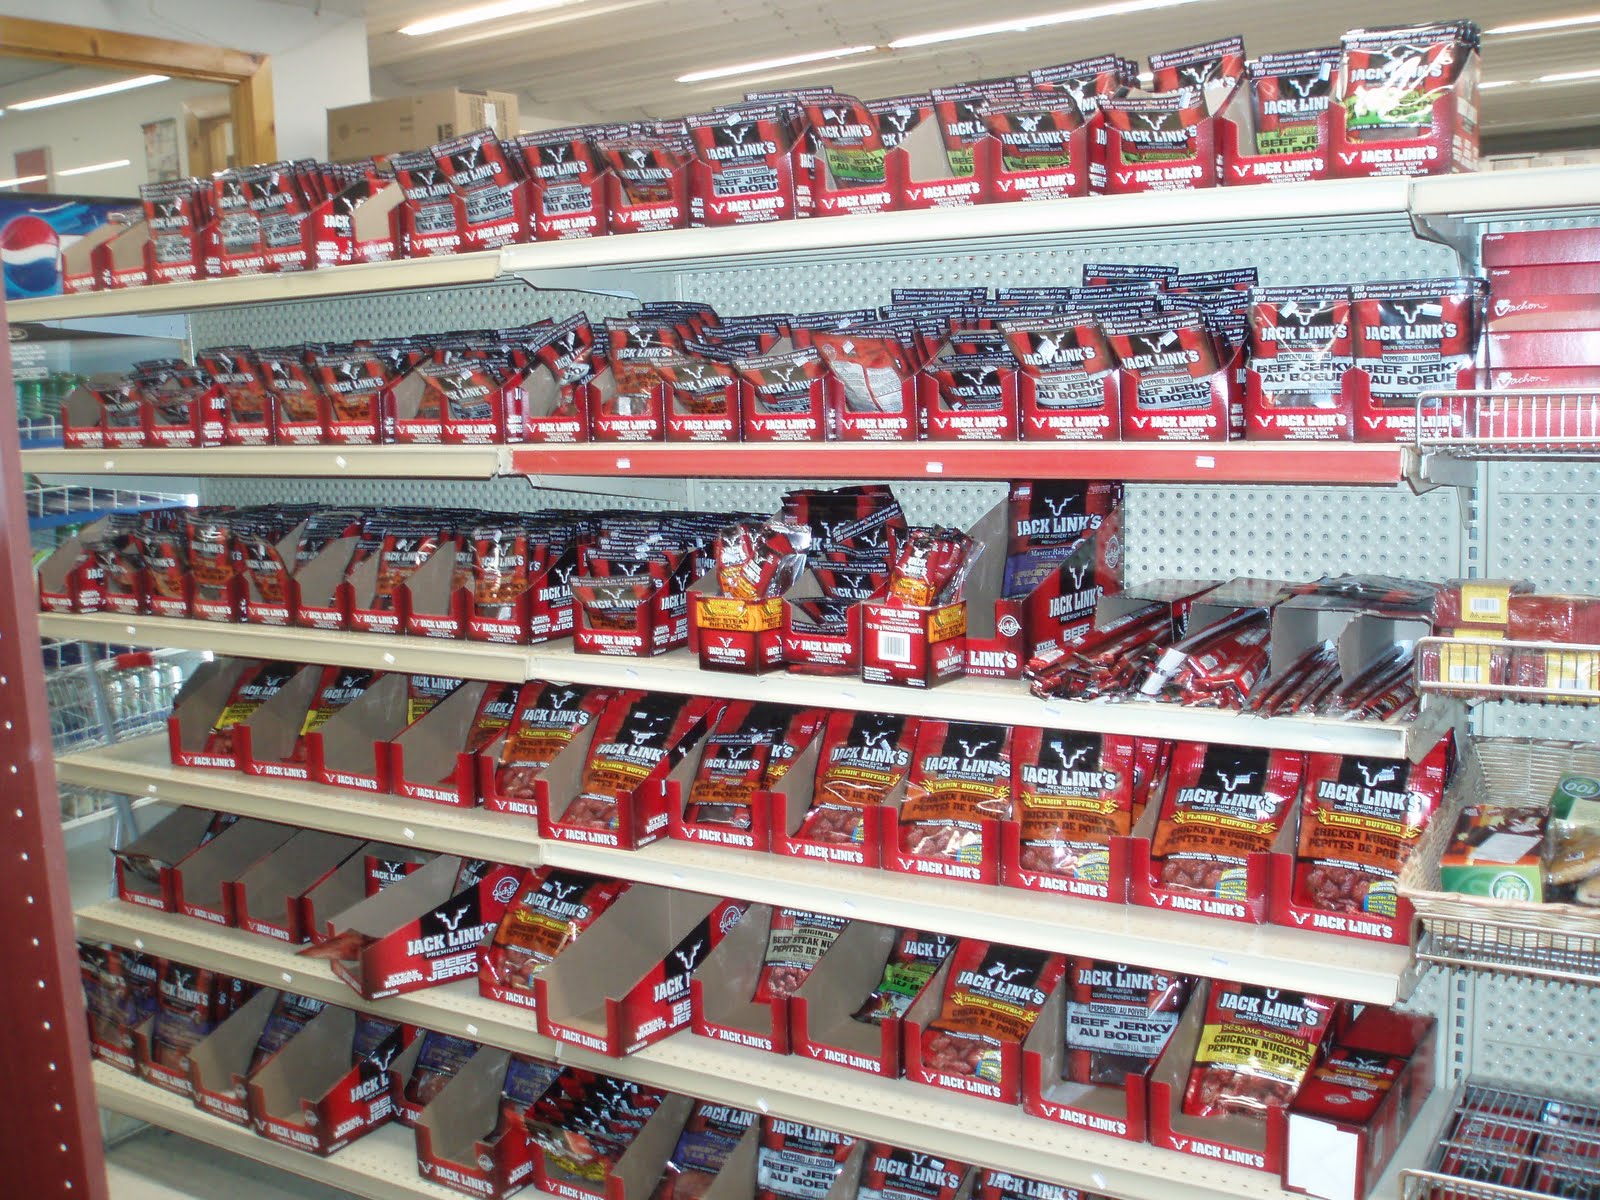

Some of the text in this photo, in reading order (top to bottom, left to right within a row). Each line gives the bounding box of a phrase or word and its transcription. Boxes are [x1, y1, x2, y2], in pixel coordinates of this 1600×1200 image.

[1264, 100, 1297, 115] JACK
[818, 124, 872, 138] JACK LINK'S
[949, 123, 972, 136] JACK
[1002, 131, 1070, 144] JACK LINK'S
[1260, 137, 1295, 148] BEEF
[706, 142, 776, 160] JACK LINK'S
[1360, 146, 1438, 164] JACK LINK'S
[472, 161, 502, 180] LINK'S
[1253, 158, 1324, 175] JACK LINK'S
[713, 174, 778, 188] BEEF JERK
[718, 182, 778, 195] AU BOEU
[726, 196, 785, 212] JACK LINK'S
[1262, 323, 1347, 341] JACK LINK'S
[1366, 322, 1457, 340] JACK LINK'S
[1024, 347, 1096, 366] JACK LINK'S
[1122, 350, 1200, 370] JACK LINK'S
[1257, 362, 1351, 373] BEEF JERKY
[1363, 364, 1403, 374] BEEF
[1264, 374, 1286, 383] AU
[1371, 375, 1393, 385] AU
[1038, 391, 1056, 400] AU
[1138, 395, 1159, 404] AU
[1049, 416, 1109, 428] JACK LINK'S
[1152, 415, 1217, 428] JACK LINK'S
[1276, 414, 1347, 426] JACK LINK'S
[1017, 514, 1103, 536] JACK LINK'S
[1053, 548, 1072, 557] Ridge
[539, 587, 559, 602] JACK
[1050, 585, 1103, 618] JACK LINK'S
[1060, 609, 1094, 622] PREMIUM CUTS
[499, 624, 521, 635] LINK'S
[1063, 623, 1090, 642] BEEF
[970, 651, 1017, 669] LINK'S
[980, 669, 1005, 677] CUTS
[522, 709, 589, 725] JACK LINK'S
[628, 744, 669, 762] LINK'
[831, 747, 908, 765] JACK LINK'S
[194, 756, 235, 768] JACK LINK'S
[265, 765, 307, 779] JACK LINK'S
[861, 771, 890, 782] BUFFALO
[1023, 766, 1116, 789] JACK LINK'S
[936, 781, 994, 793] FLAMIN' BUFFALO
[417, 787, 459, 803] JACK LINK'S
[1178, 788, 1277, 813] JACK LINK'S
[1319, 781, 1420, 813] JACK LINK'S
[1034, 797, 1100, 809] FLAMIN' BUFFALO
[1346, 801, 1373, 811] PREMIUM
[1186, 813, 1257, 830] FLAMIN' BUFFALO
[1329, 814, 1401, 832] FLAMIN' BUFFALO
[565, 831, 618, 846] JACK LINK'S
[698, 829, 754, 847] JACK LINK'S
[1313, 827, 1362, 839] CHICKEN
[1358, 843, 1372, 853] DE
[407, 922, 497, 957] JACK LINK'S
[772, 936, 819, 946] BEEF STEAK
[799, 929, 834, 939] ORIGINAL
[426, 946, 460, 958] PREMIUM
[806, 947, 817, 955] DE
[904, 940, 935, 957] JACK
[431, 952, 477, 971] BEEF
[385, 974, 423, 989] NUGGETS
[388, 970, 419, 982] STEAK
[1078, 969, 1168, 991] JACK LINK'S
[654, 978, 683, 1003] JACK
[1092, 1004, 1116, 1012] PEPPERED
[1220, 993, 1318, 1026] JACK LINK'S
[1071, 1016, 1172, 1033] BEEF JERKY
[561, 1029, 607, 1052] JACK LINK'S
[1079, 1028, 1162, 1043] AU BOEUF
[1214, 1035, 1312, 1063] CHICKEN NUGGETS
[1254, 1050, 1269, 1060] DE
[269, 1121, 292, 1139] JACK
[293, 1128, 319, 1148] LINK'S
[763, 1159, 798, 1171] BEEF
[435, 1167, 494, 1194] JACK LINK'S
[769, 1172, 789, 1183] AU
[874, 1157, 959, 1189] JACK LINK'S
